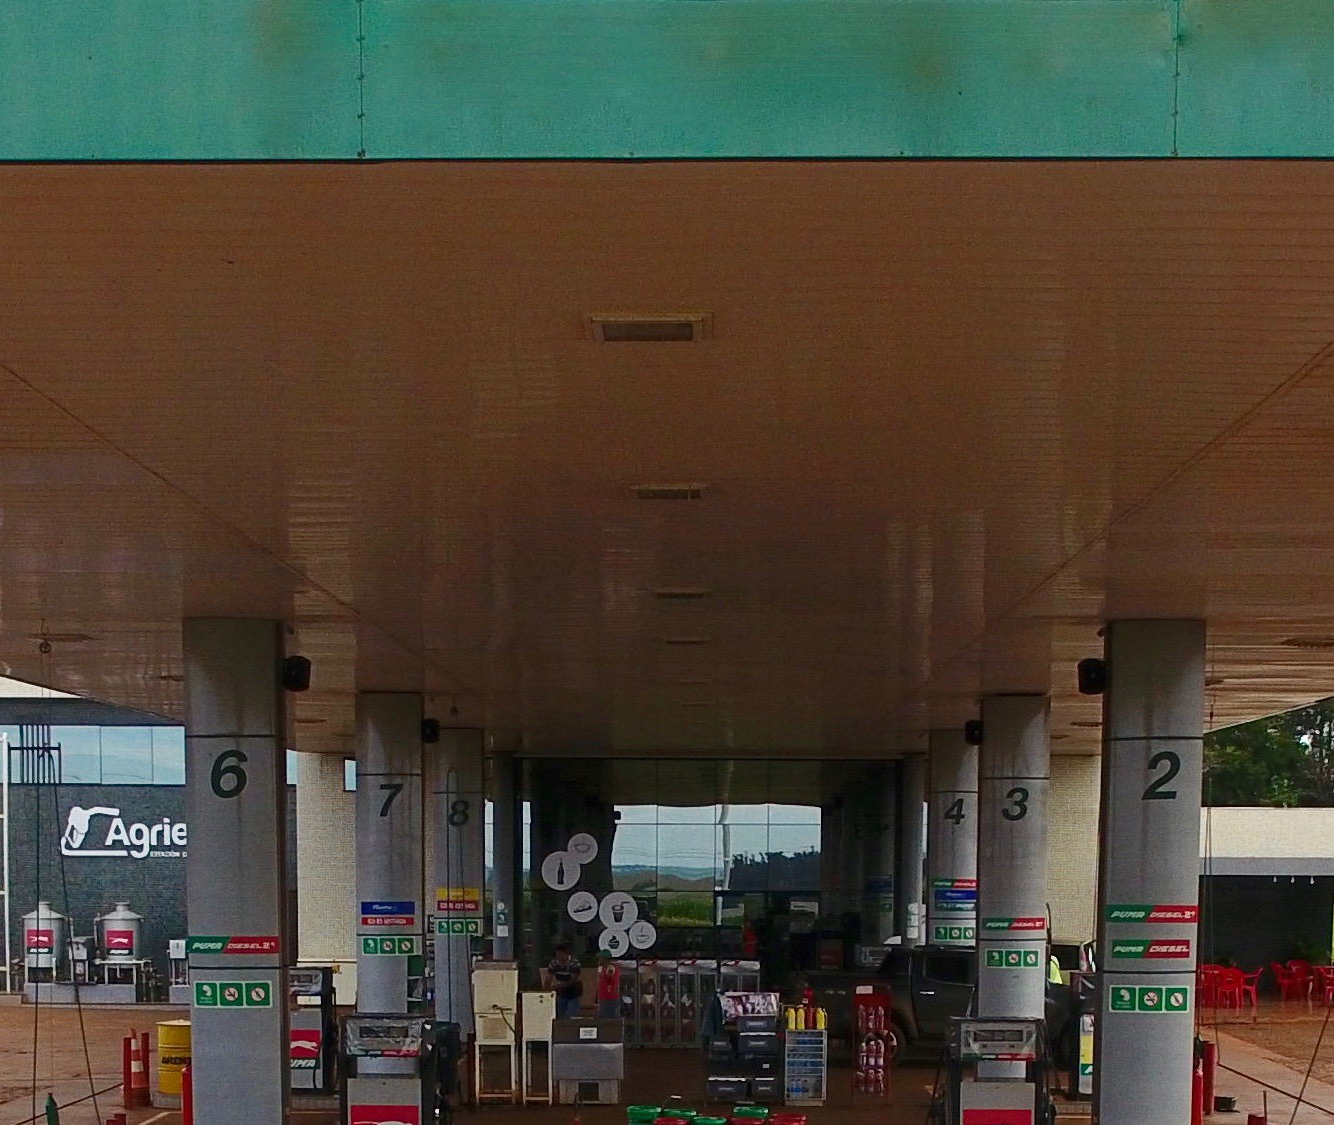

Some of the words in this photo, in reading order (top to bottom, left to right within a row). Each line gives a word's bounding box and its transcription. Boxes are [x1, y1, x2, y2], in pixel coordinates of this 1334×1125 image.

[210, 749, 249, 799] 6
[1141, 751, 1181, 801] 2
[379, 782, 403, 818] 7
[447, 798, 471, 828] 8
[943, 797, 966, 826] 4
[1000, 786, 1029, 822] 3
